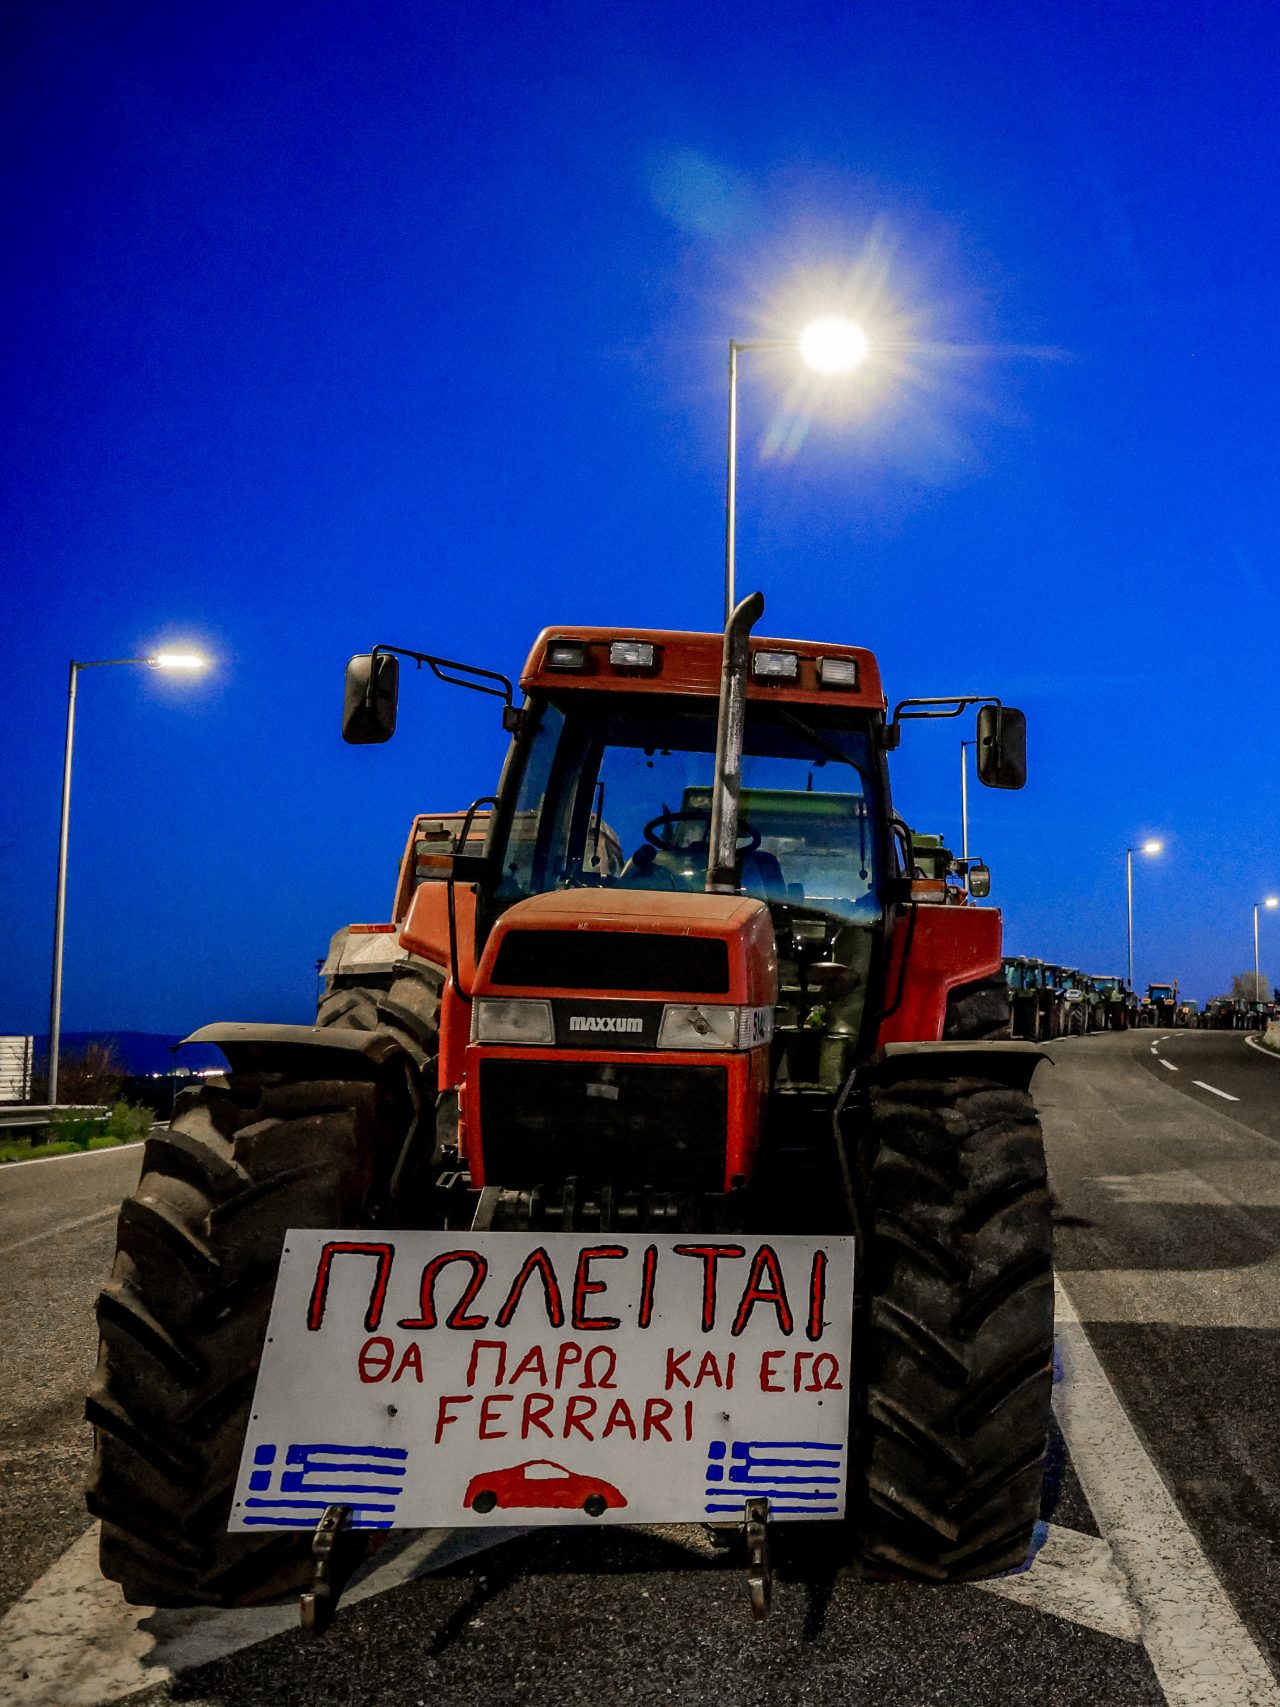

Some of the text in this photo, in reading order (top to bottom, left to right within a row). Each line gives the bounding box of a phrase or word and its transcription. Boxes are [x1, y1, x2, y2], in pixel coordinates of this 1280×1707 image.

[569, 1016, 643, 1033] MAXXUM
[306, 1241, 827, 1341] ΠΩΛΕΙΤΑΙ
[358, 1336, 842, 1392] ΘΑ ΠΑΡΩ ΚΑΙ ΕΓΩ
[435, 1393, 693, 1444] FERRARI
